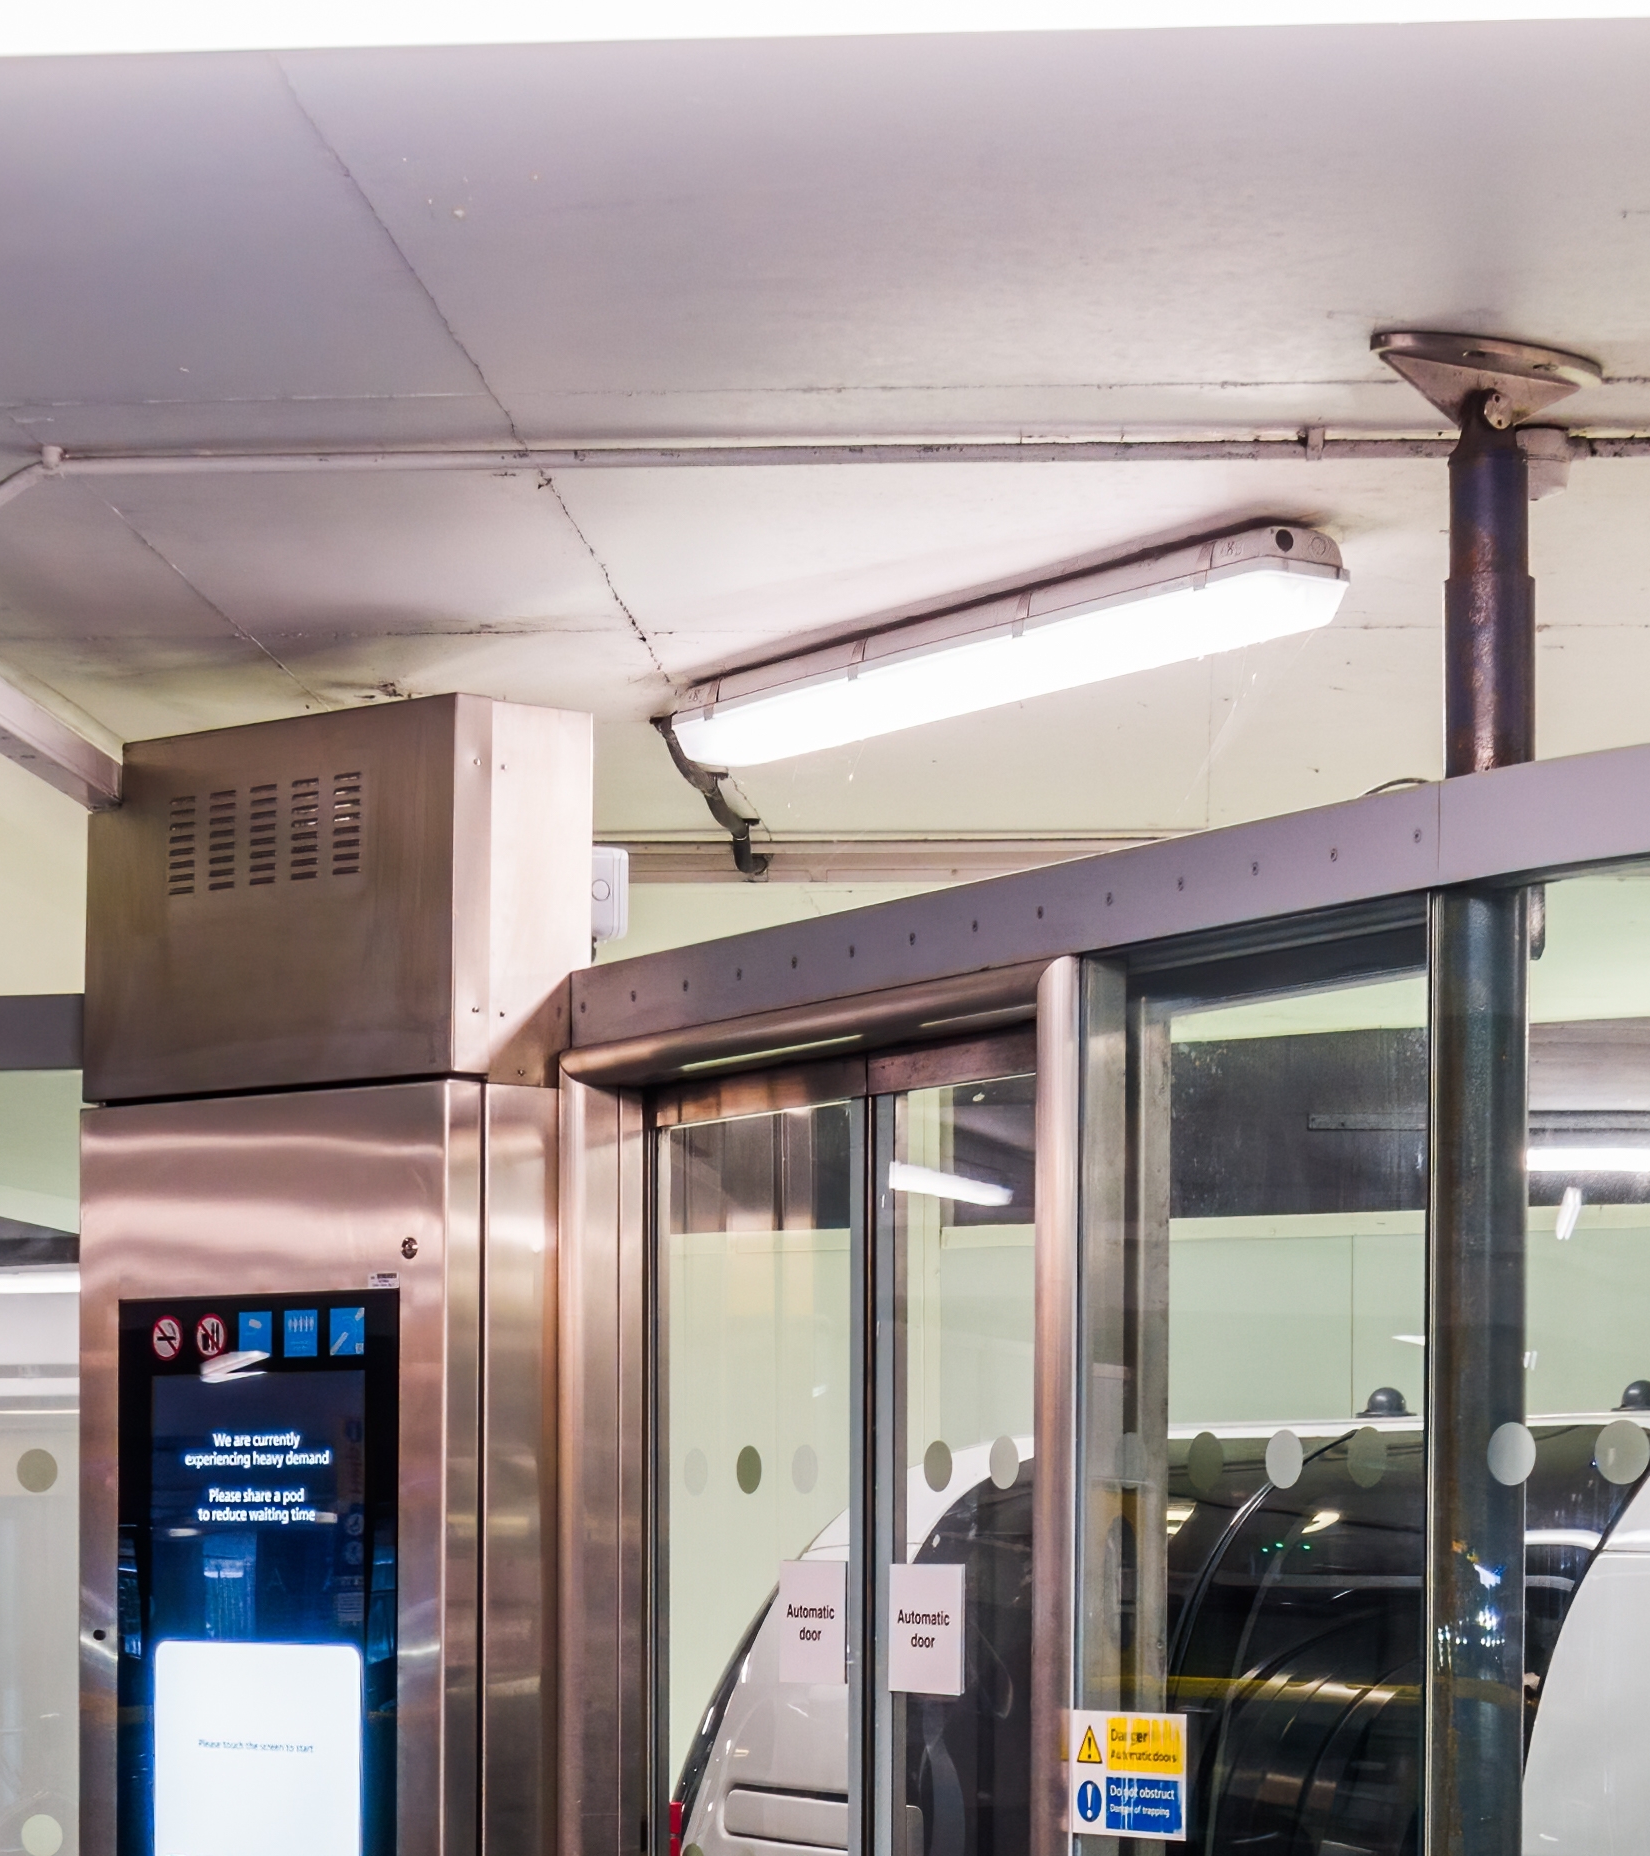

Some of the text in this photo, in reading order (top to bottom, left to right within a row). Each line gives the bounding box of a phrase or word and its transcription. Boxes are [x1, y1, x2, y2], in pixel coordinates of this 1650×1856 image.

[212, 1431, 301, 1449] We are currently
[184, 1449, 330, 1469] experiencing heavy demand
[208, 1488, 305, 1505] Please share a pod
[197, 1507, 316, 1525] to reduce waiting time
[786, 1603, 835, 1620] Automatic
[897, 1609, 951, 1626] Automatic
[799, 1627, 822, 1641] door
[910, 1633, 936, 1648] door
[1111, 1728, 1148, 1746] Dager
[1109, 1784, 1122, 1797] Do
[1139, 1786, 1175, 1800] obstruct
[1134, 1805, 1142, 1814] of
[1142, 1806, 1170, 1819] trapping
